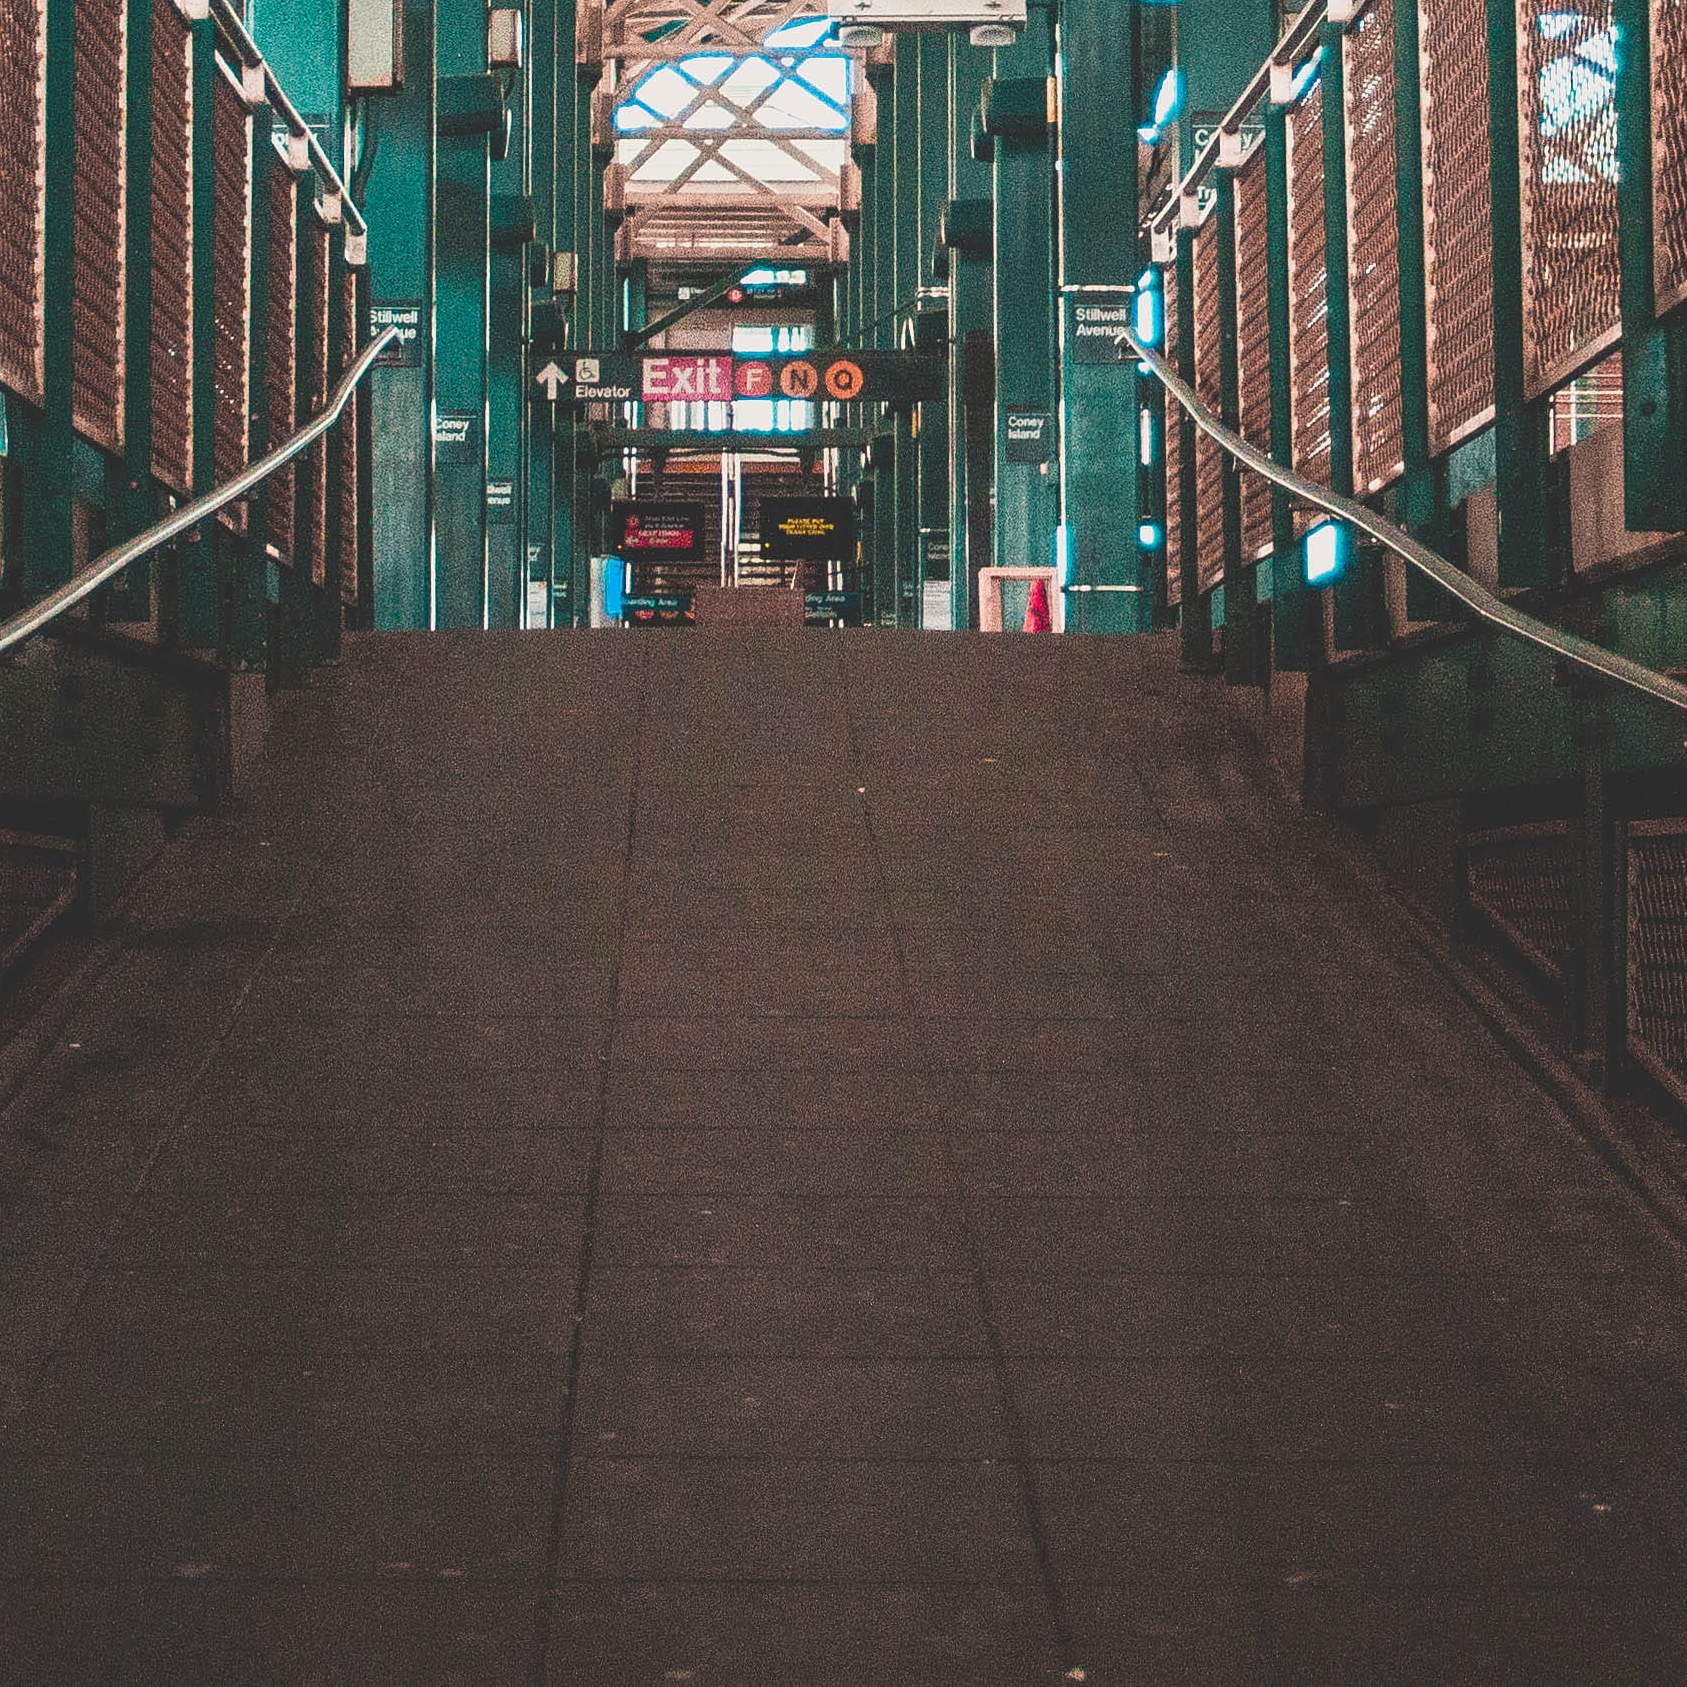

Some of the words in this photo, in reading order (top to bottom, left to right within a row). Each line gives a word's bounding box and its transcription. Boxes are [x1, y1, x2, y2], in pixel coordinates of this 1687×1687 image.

[370, 310, 418, 324] Stillwell
[1076, 308, 1126, 321] Stillwell
[643, 357, 722, 394] Exit
[746, 369, 762, 390] F
[790, 369, 808, 390] N
[834, 369, 854, 390] Q
[575, 385, 631, 398] Elevator
[435, 418, 469, 431] Coney
[1008, 416, 1044, 428] Coney
[1008, 428, 1041, 439] Island
